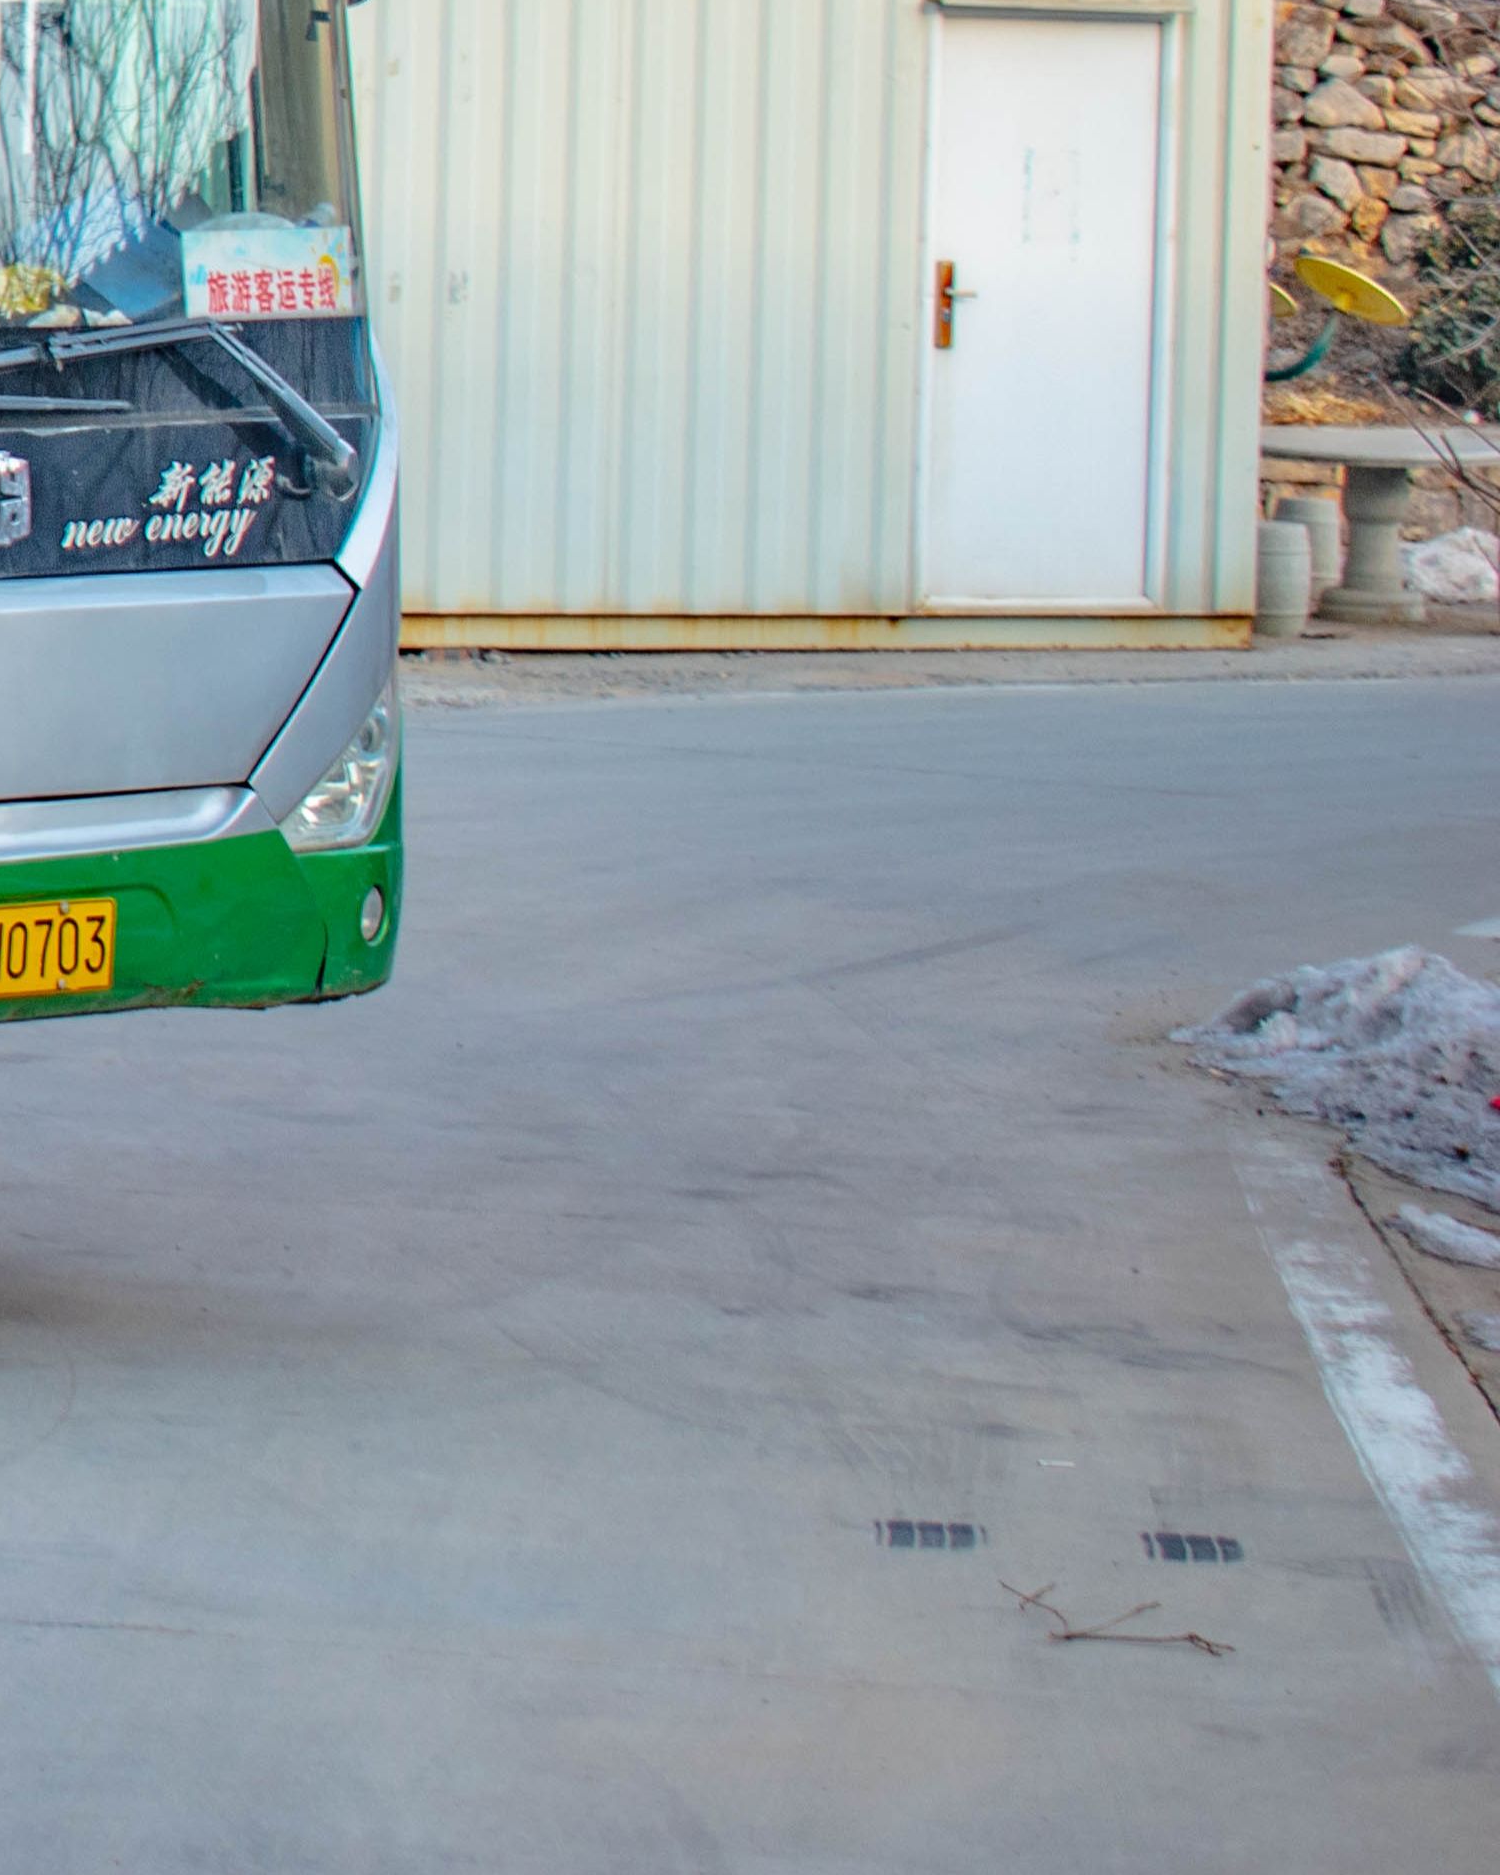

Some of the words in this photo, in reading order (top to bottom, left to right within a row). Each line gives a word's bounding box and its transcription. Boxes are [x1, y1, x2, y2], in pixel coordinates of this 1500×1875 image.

[206, 265, 337, 315] 旅游客运专线
[148, 455, 276, 512] 新能源
[60, 515, 139, 550] new
[145, 507, 258, 558] energy
